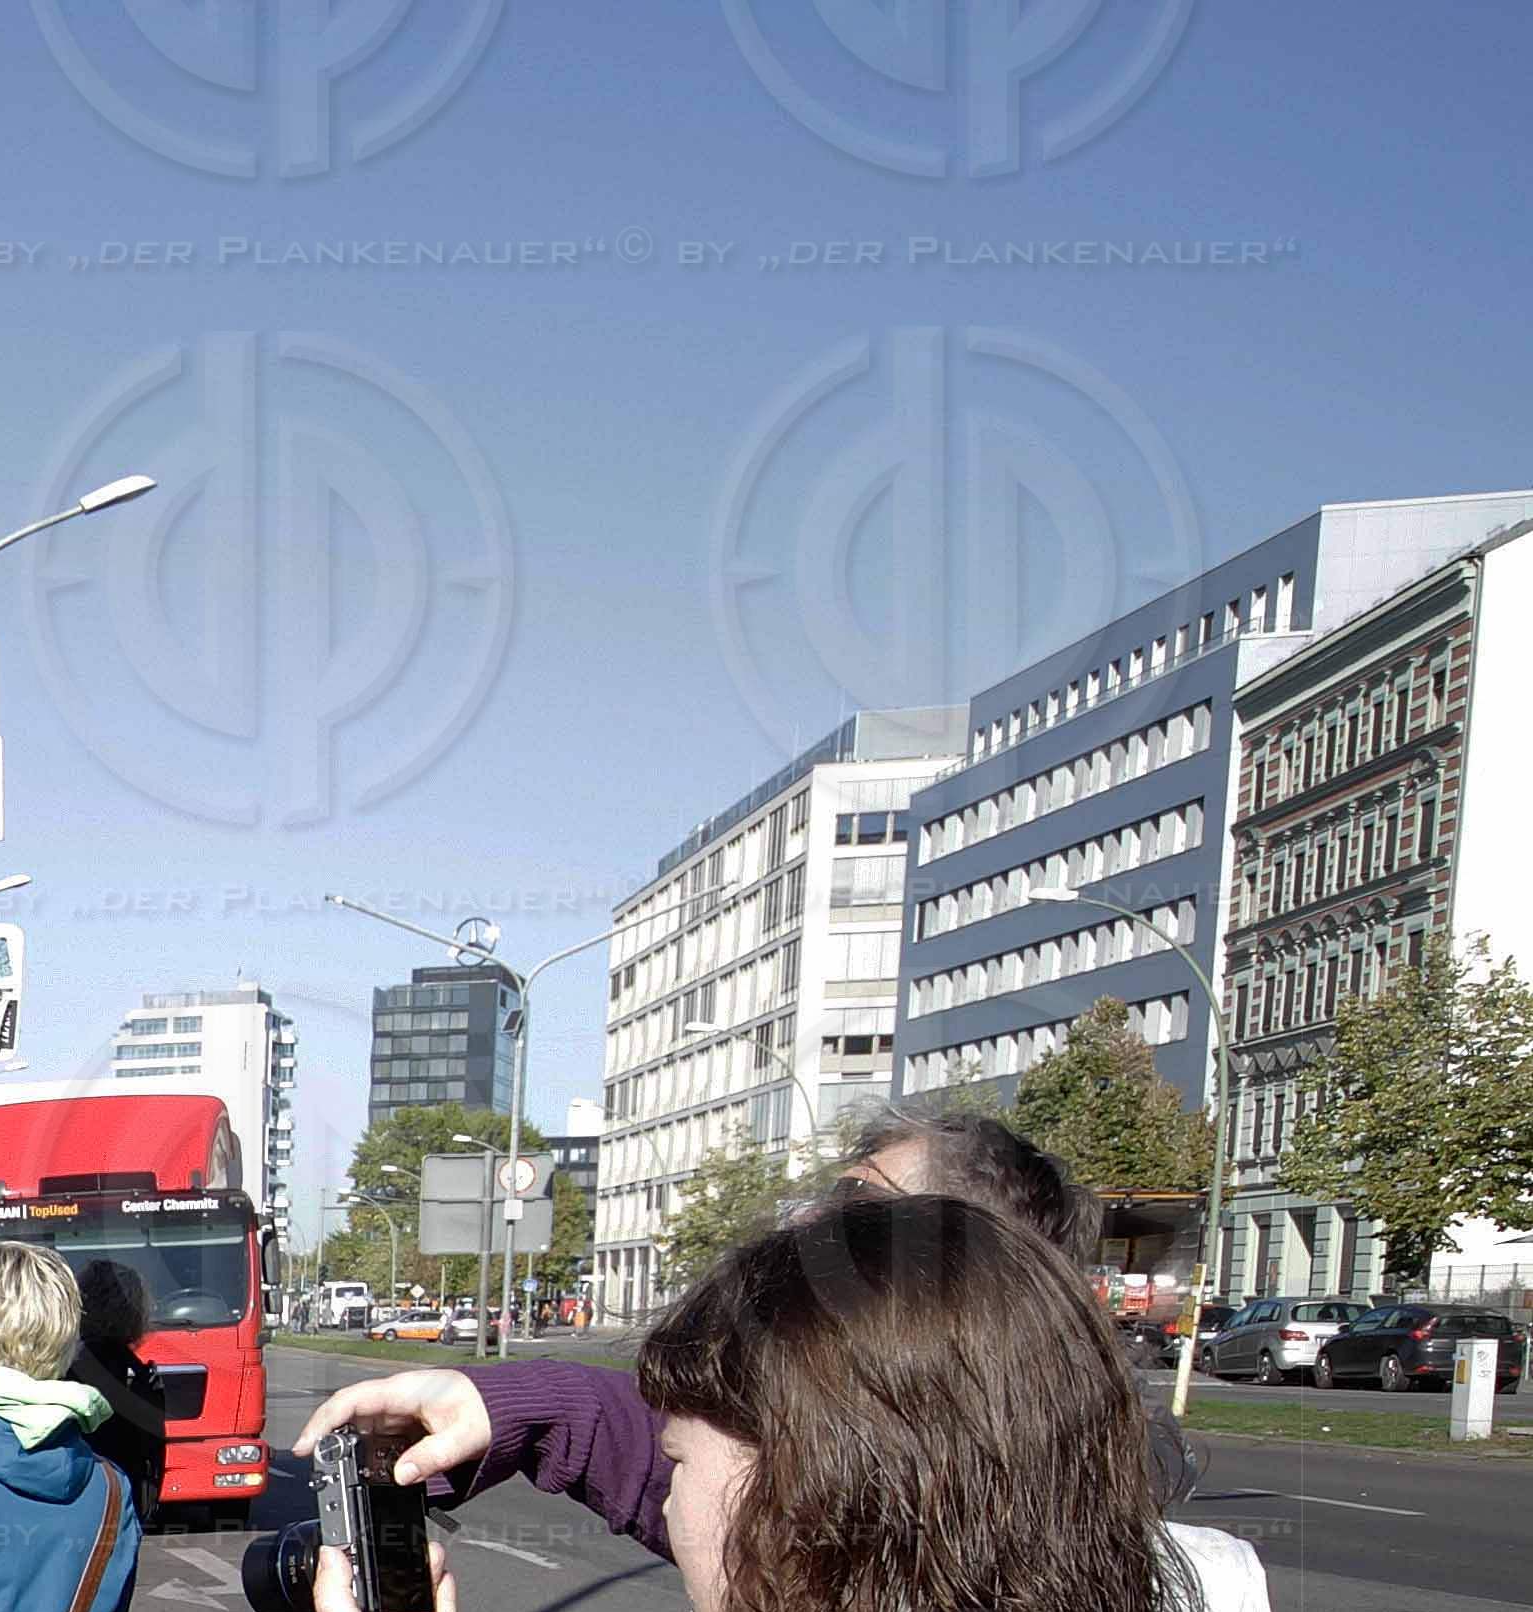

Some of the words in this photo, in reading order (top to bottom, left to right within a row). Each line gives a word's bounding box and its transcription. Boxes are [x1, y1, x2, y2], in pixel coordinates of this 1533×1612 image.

[28, 1203, 79, 1218] TopUsed
[121, 1199, 162, 1213] Center
[163, 1197, 220, 1211] Chemnitz
